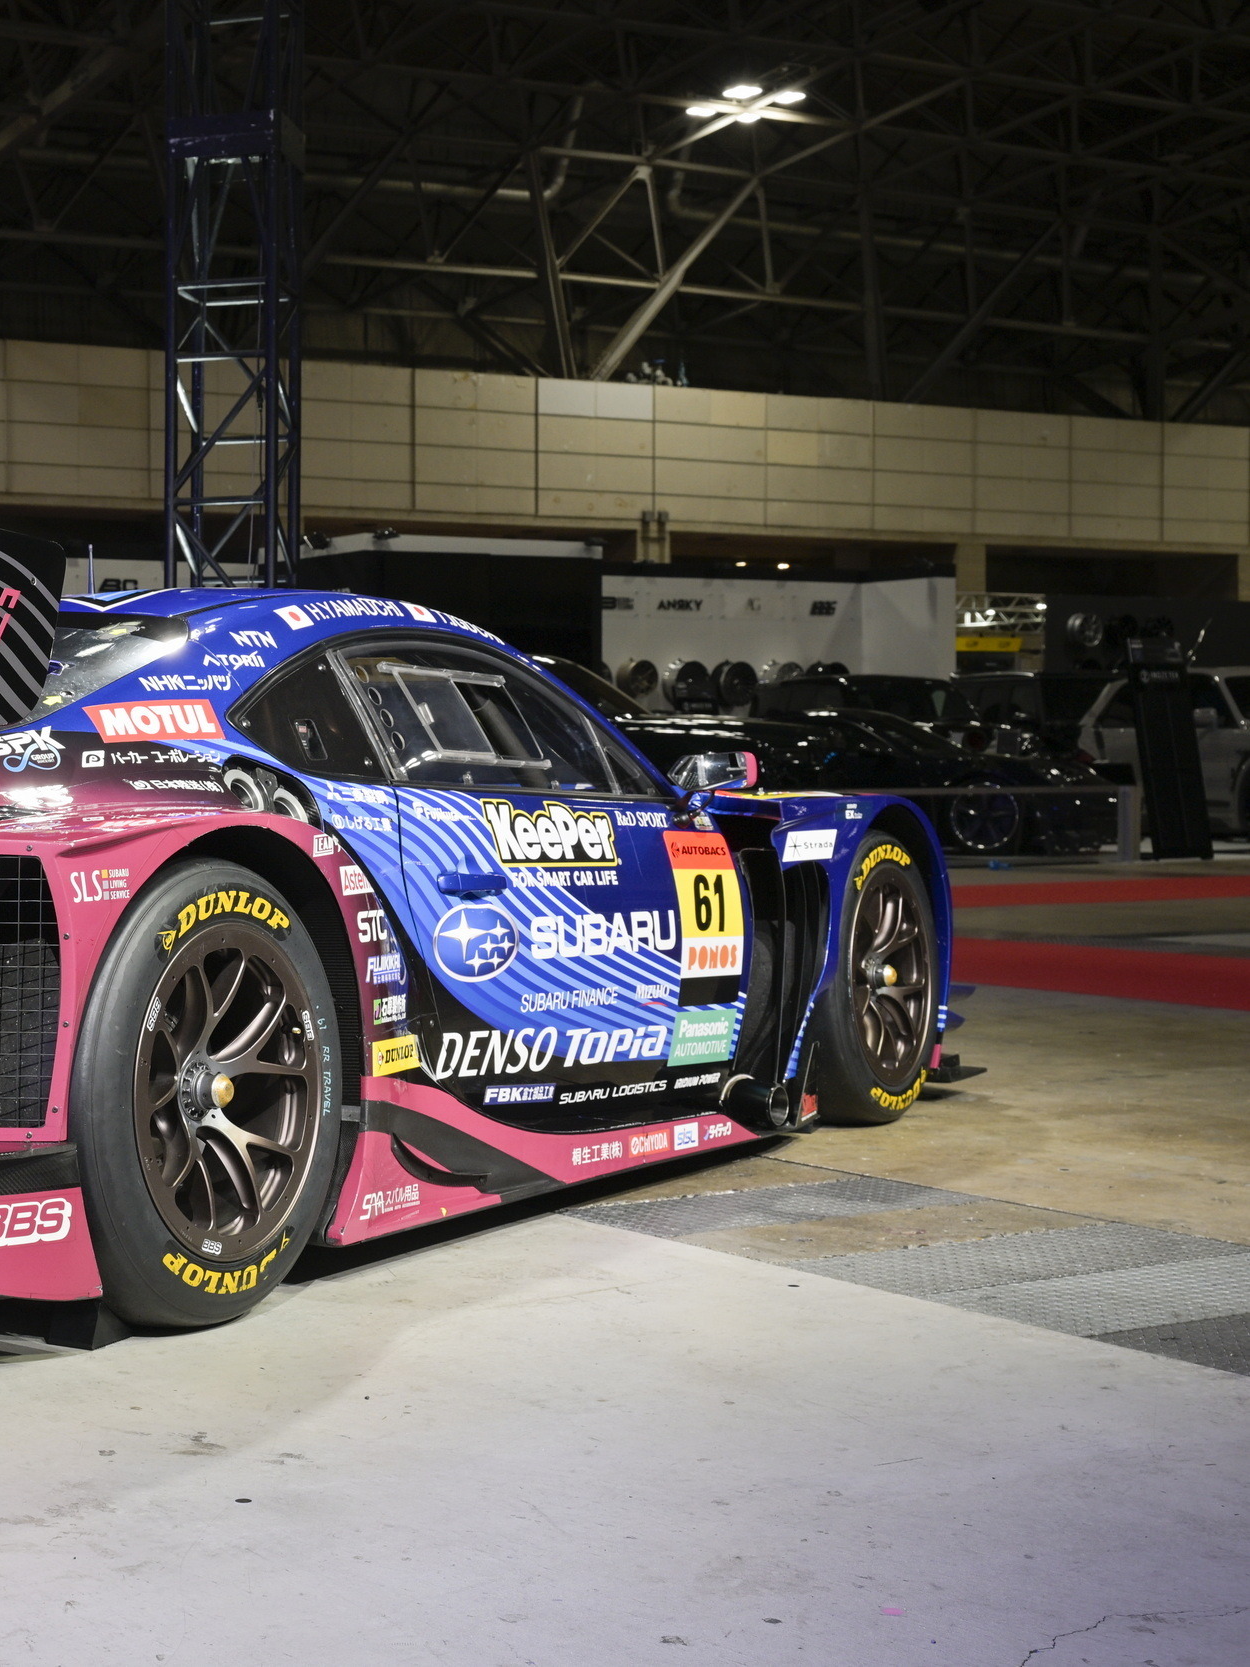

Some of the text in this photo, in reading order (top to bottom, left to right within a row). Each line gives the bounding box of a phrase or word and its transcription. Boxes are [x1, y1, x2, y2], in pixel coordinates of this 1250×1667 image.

[229, 631, 278, 648] NTN
[99, 703, 217, 737] MOTUL
[487, 800, 614, 861] KeePer
[616, 810, 668, 828] R&D SPORT
[681, 845, 726, 857] AUTOBACS
[861, 844, 911, 881] DUNLOP
[70, 870, 102, 903] SLS
[512, 870, 618, 888] FOR SMART CAR LIFE
[178, 890, 290, 938] DUNLOP
[693, 873, 725, 933] 61
[357, 909, 387, 943] STC
[530, 909, 676, 960] SUBARU
[688, 943, 738, 971] PONOS
[520, 986, 619, 1013] SUBARU FINANCE
[635, 984, 670, 999] MIZUHO
[679, 1016, 729, 1039] Panasonic
[322, 1045, 330, 1062] RR
[384, 1044, 414, 1064] DUNLOP
[436, 1025, 558, 1080] DENSO
[674, 1039, 727, 1057] AUTOMOTIVE
[322, 1071, 332, 1117] TRAVEL
[485, 1086, 522, 1103] FBK
[559, 1080, 667, 1105] SUBARU LOGISTICS
[639, 1132, 668, 1152] CHIYODA
[202, 1239, 222, 1255] BBS
